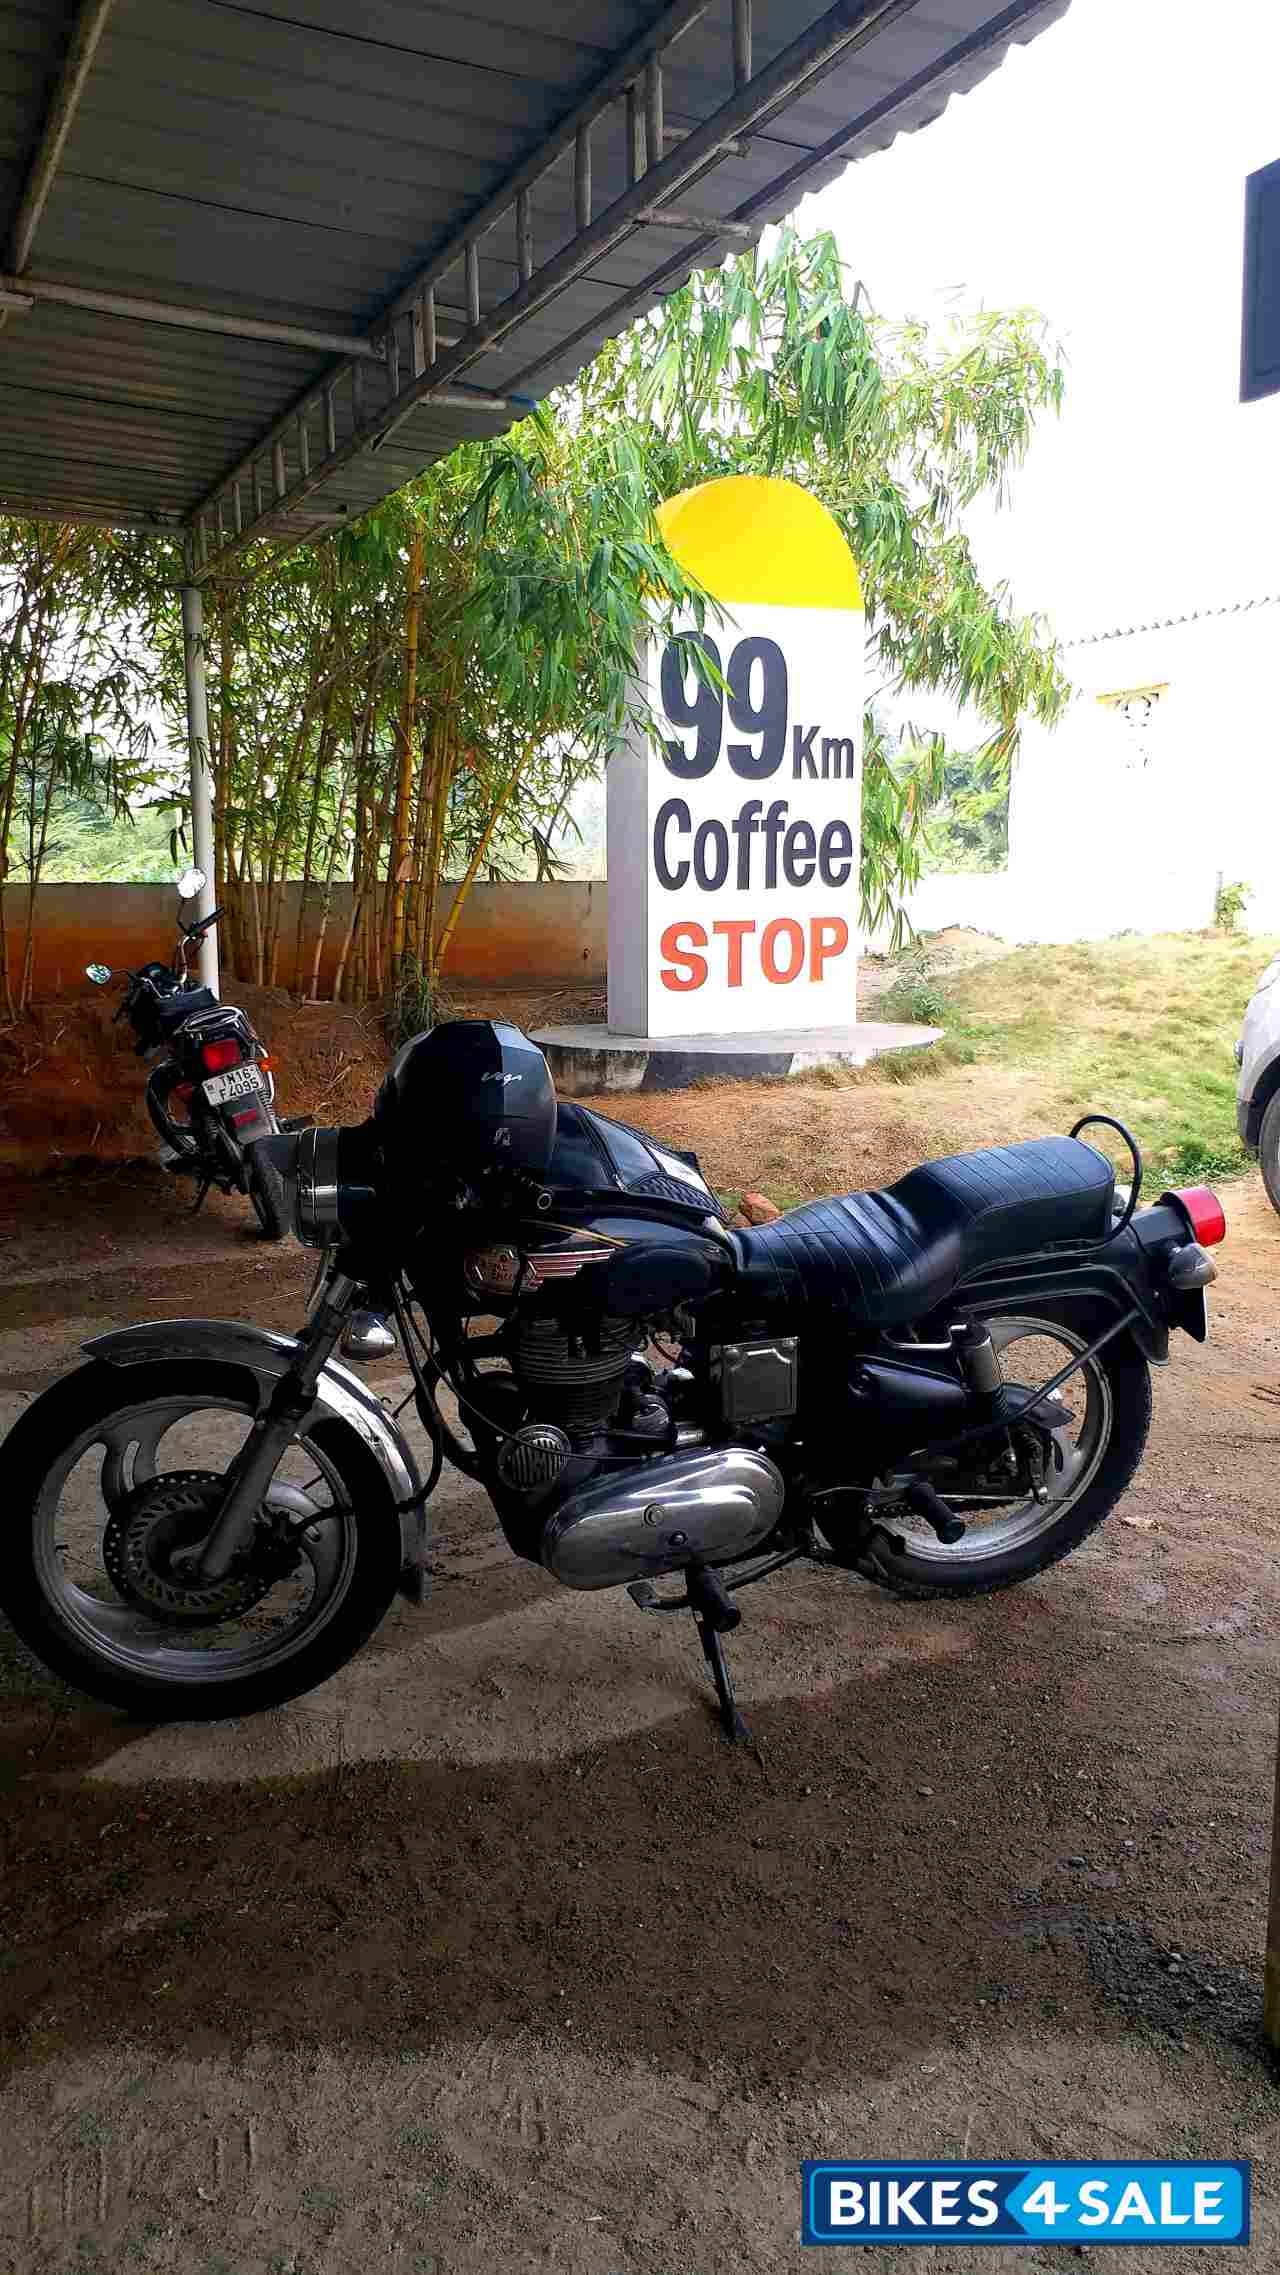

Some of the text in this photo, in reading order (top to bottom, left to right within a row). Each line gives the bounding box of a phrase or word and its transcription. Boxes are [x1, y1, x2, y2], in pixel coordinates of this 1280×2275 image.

[660, 631, 854, 780] 99 Km
[653, 798, 853, 891] Coffee
[660, 917, 849, 992] STOP
